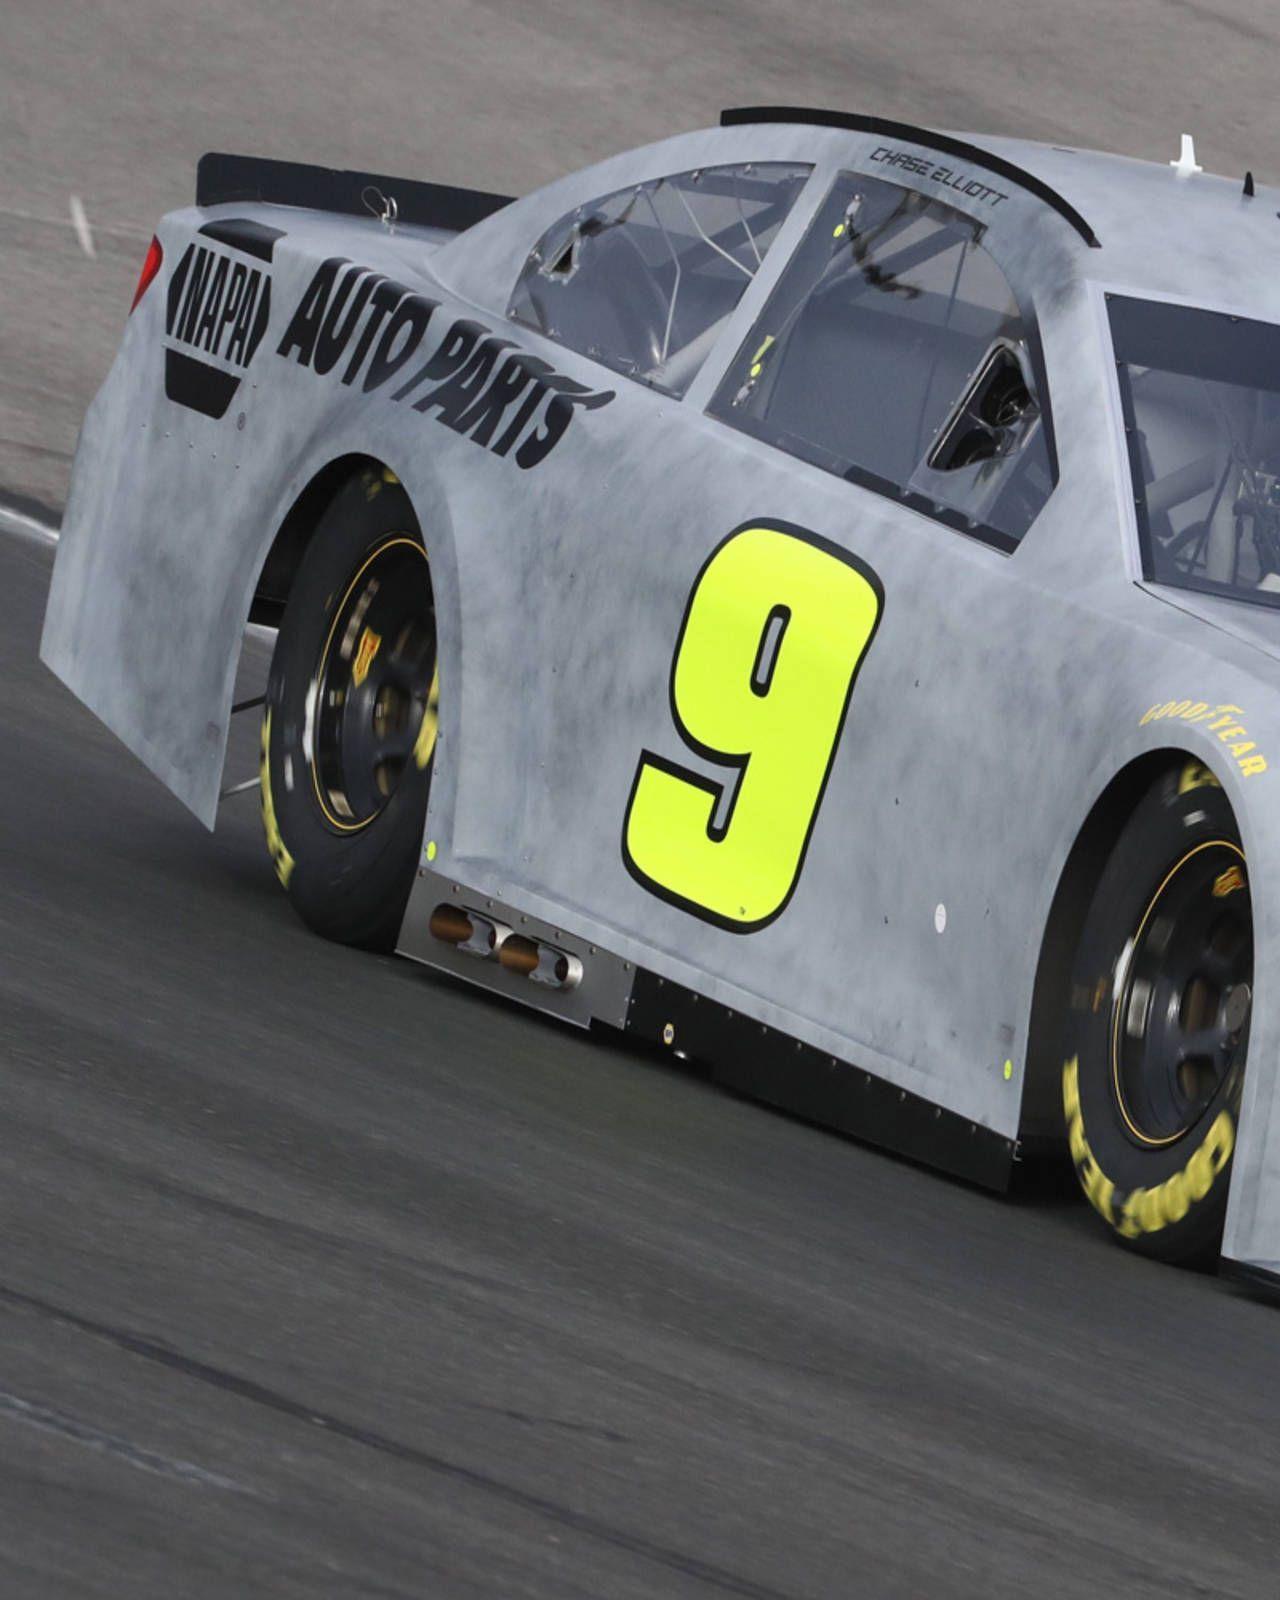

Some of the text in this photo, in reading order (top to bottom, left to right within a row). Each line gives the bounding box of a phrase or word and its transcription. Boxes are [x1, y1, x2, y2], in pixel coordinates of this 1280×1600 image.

[869, 147, 1008, 206] CHASE ELLIOTT
[176, 246, 616, 470] NAPA AUTO PARTS
[621, 517, 885, 934] 9
[1138, 700, 1268, 778] GOODYEAR
